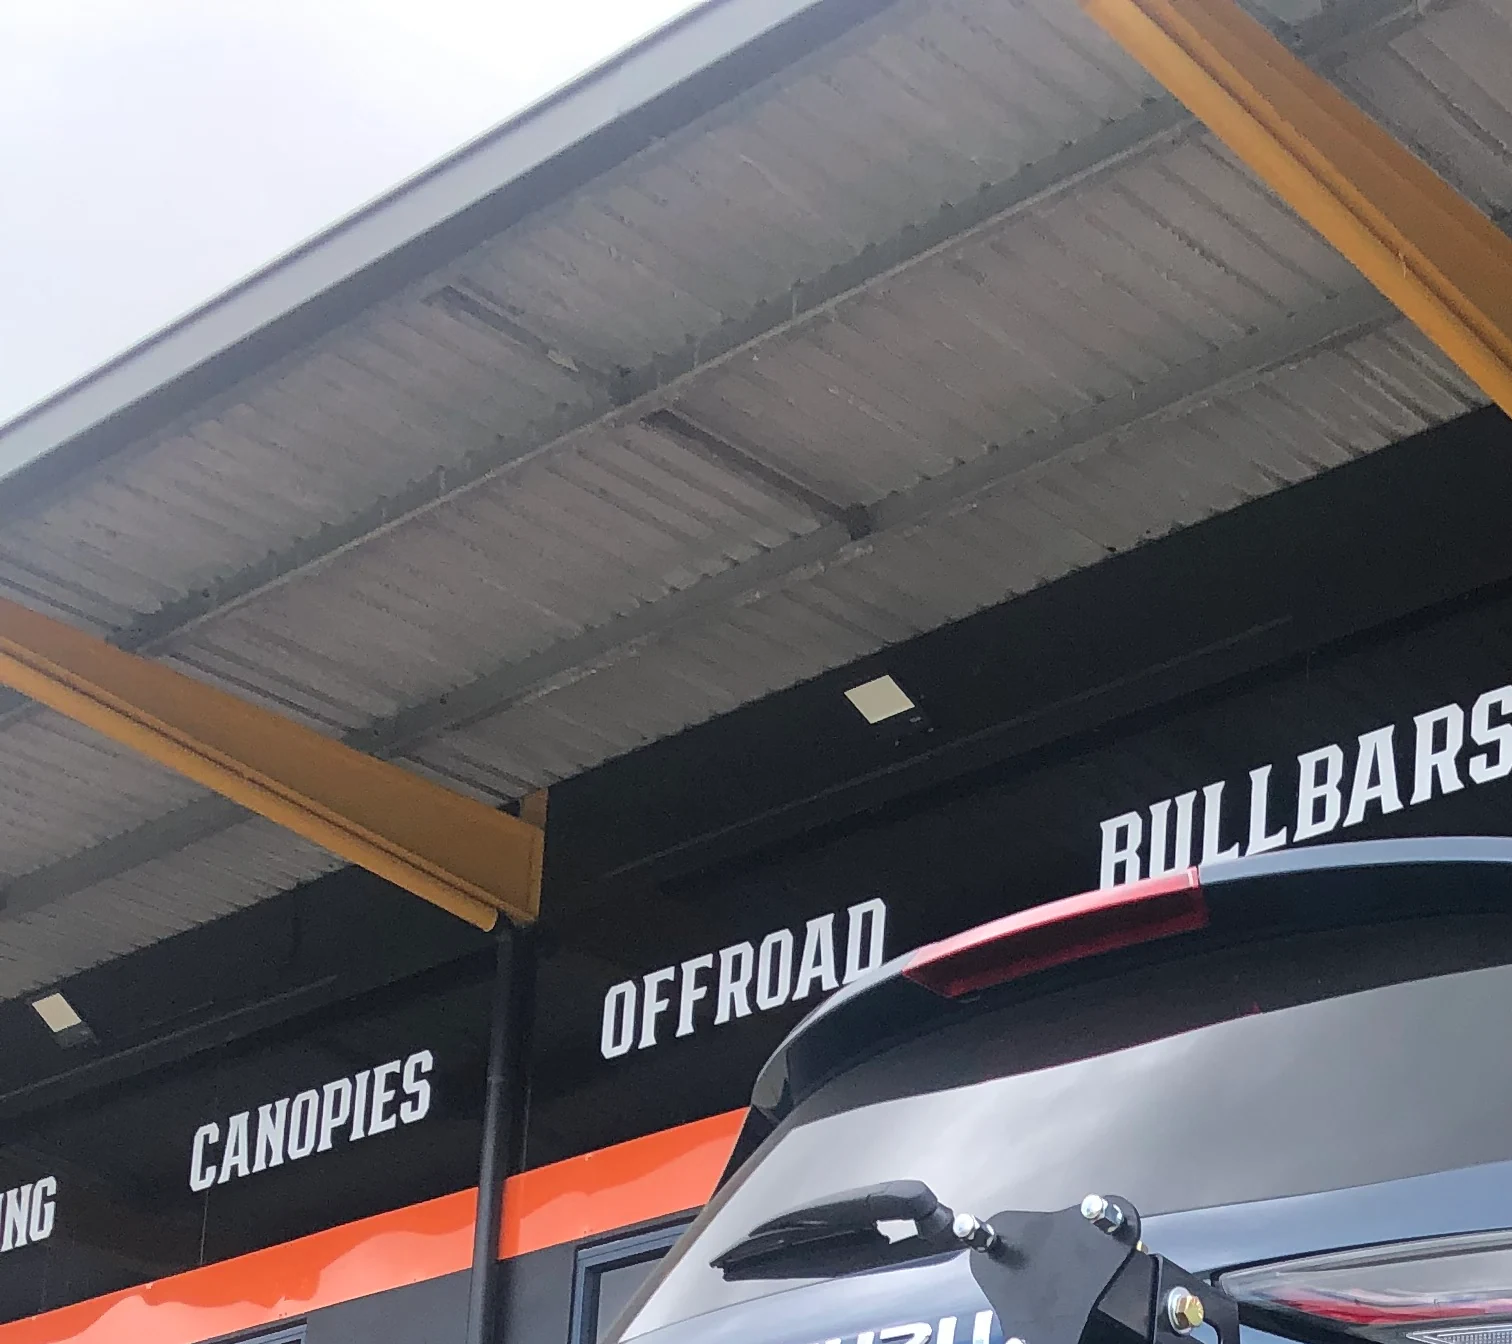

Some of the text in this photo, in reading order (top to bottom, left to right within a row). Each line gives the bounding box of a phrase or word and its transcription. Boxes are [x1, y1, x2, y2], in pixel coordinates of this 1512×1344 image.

[601, 898, 887, 1060] OFFROAD
[190, 1050, 433, 1192] CANOPIES
[0, 1176, 57, 1252] NG
